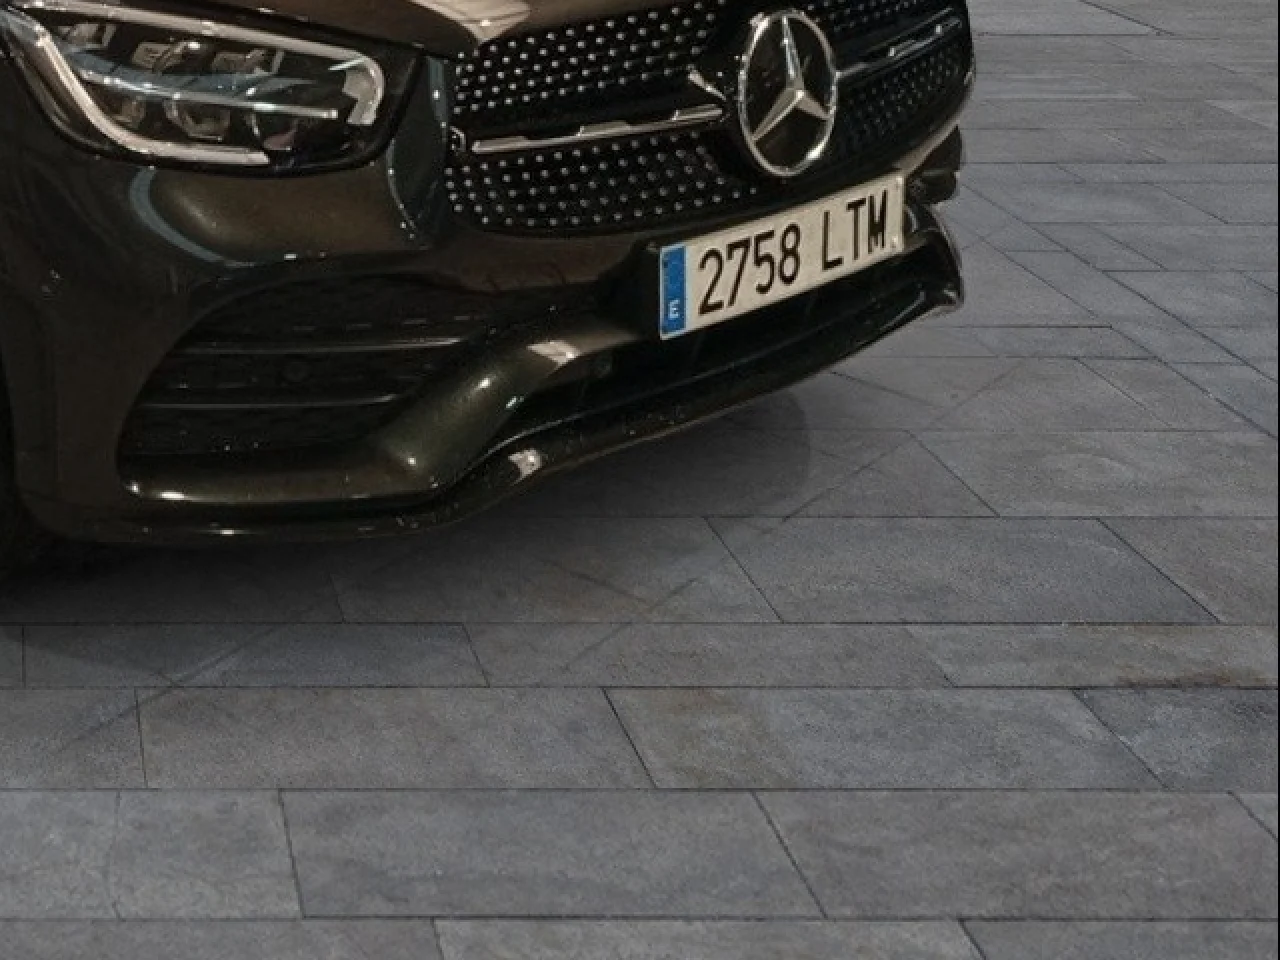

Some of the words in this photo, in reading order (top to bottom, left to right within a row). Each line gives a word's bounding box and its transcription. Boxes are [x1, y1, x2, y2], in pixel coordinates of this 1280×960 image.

[698, 222, 802, 315] 2758
[821, 189, 888, 271] LTM
[668, 299, 679, 319] E
